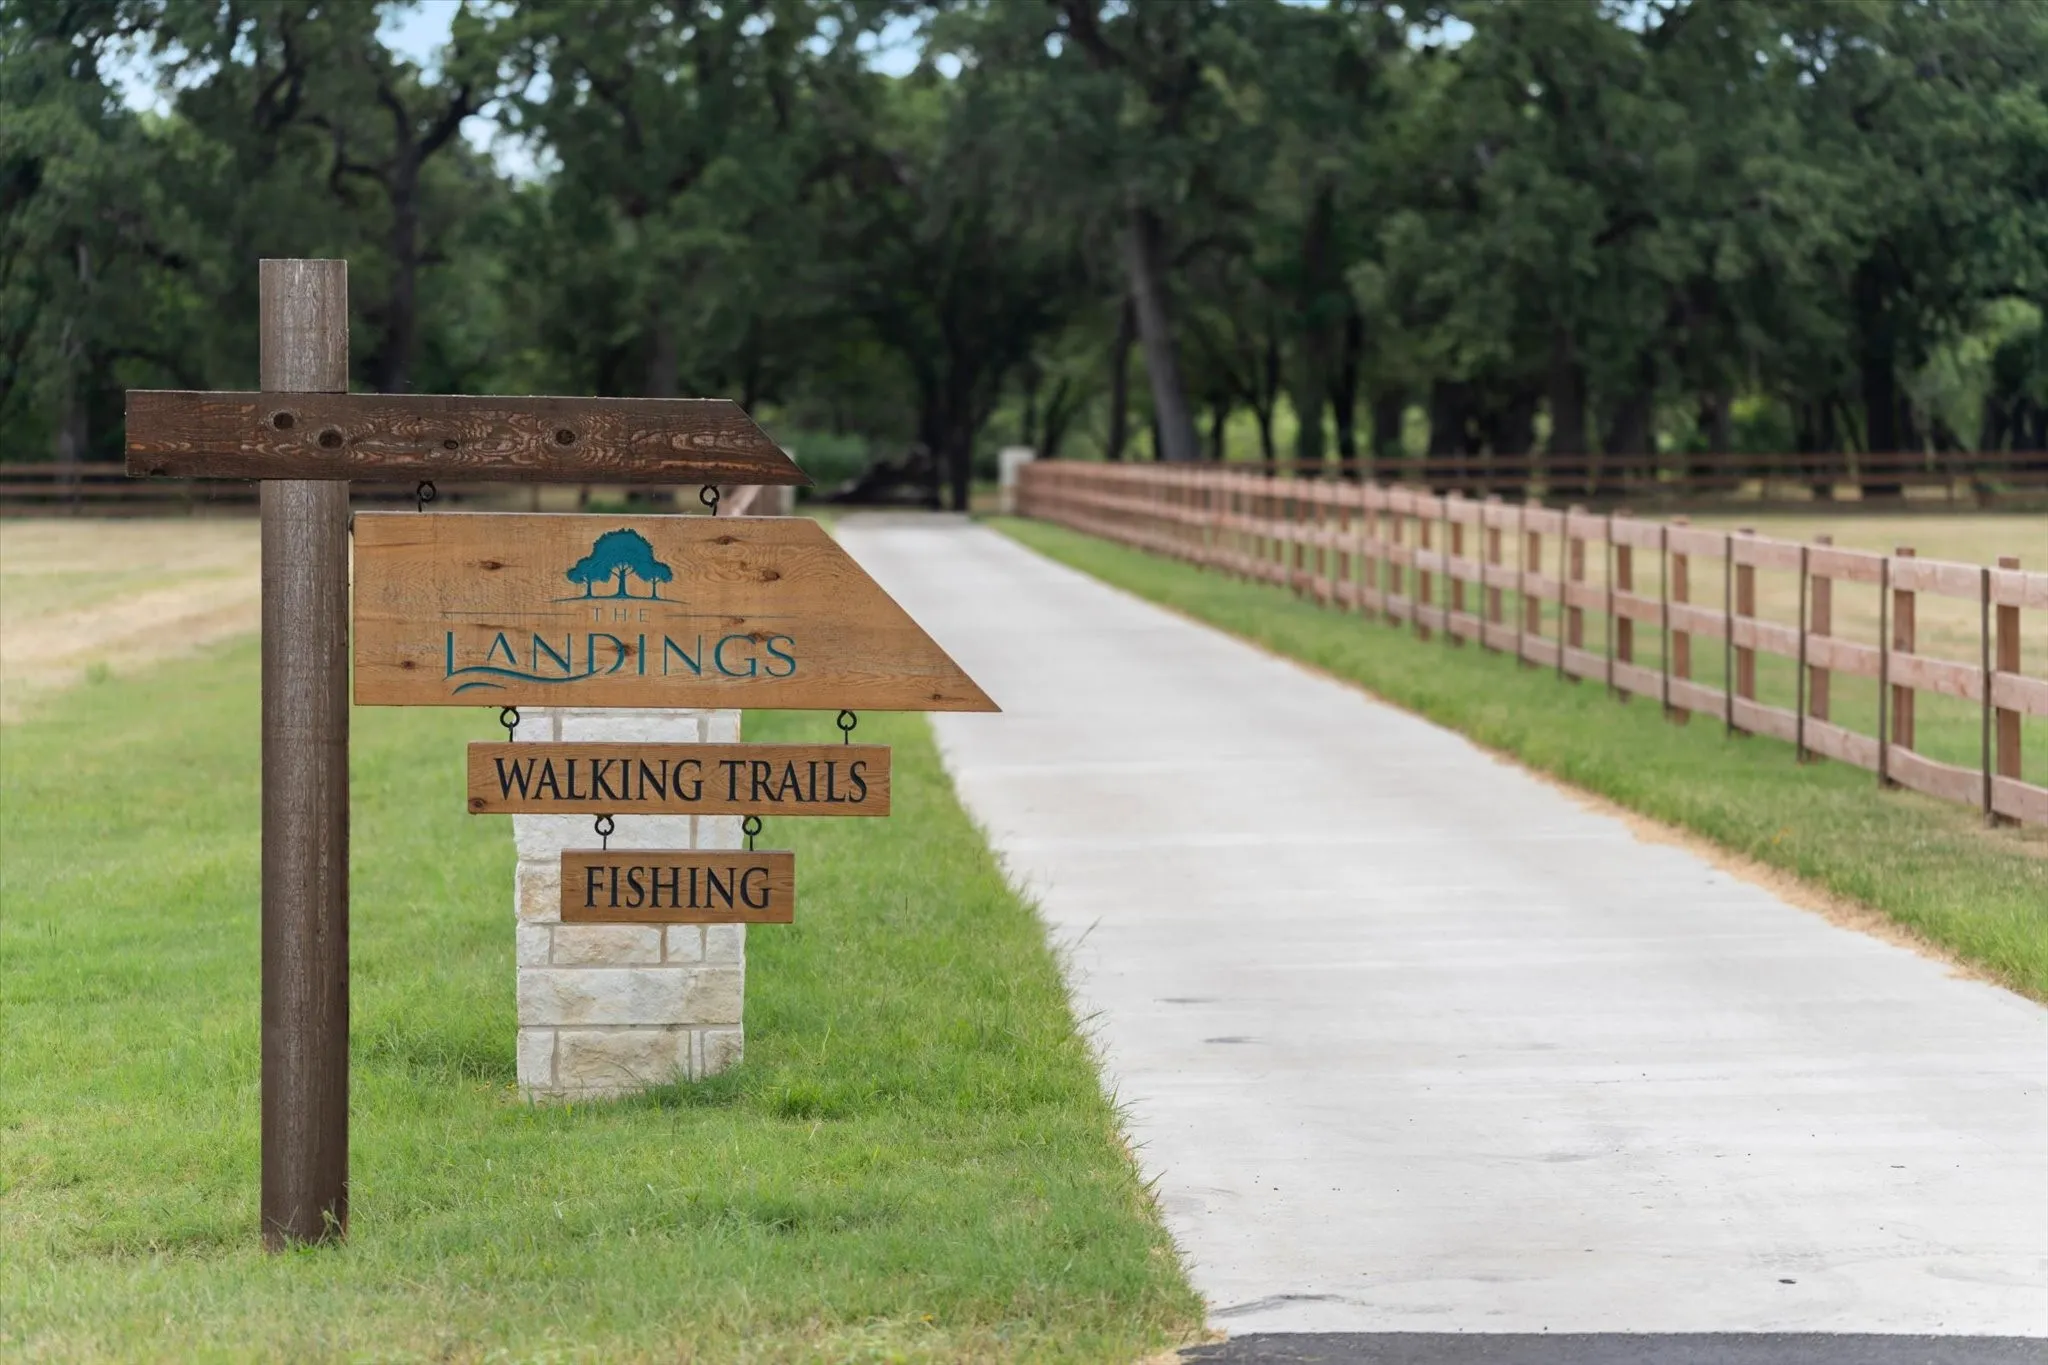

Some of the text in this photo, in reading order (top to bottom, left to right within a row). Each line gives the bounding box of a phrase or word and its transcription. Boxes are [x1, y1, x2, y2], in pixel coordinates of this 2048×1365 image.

[592, 607, 651, 623] THE
[445, 631, 797, 679] LANDINGS
[493, 757, 868, 803] WALKING TRAILS
[584, 865, 771, 910] FISHING
